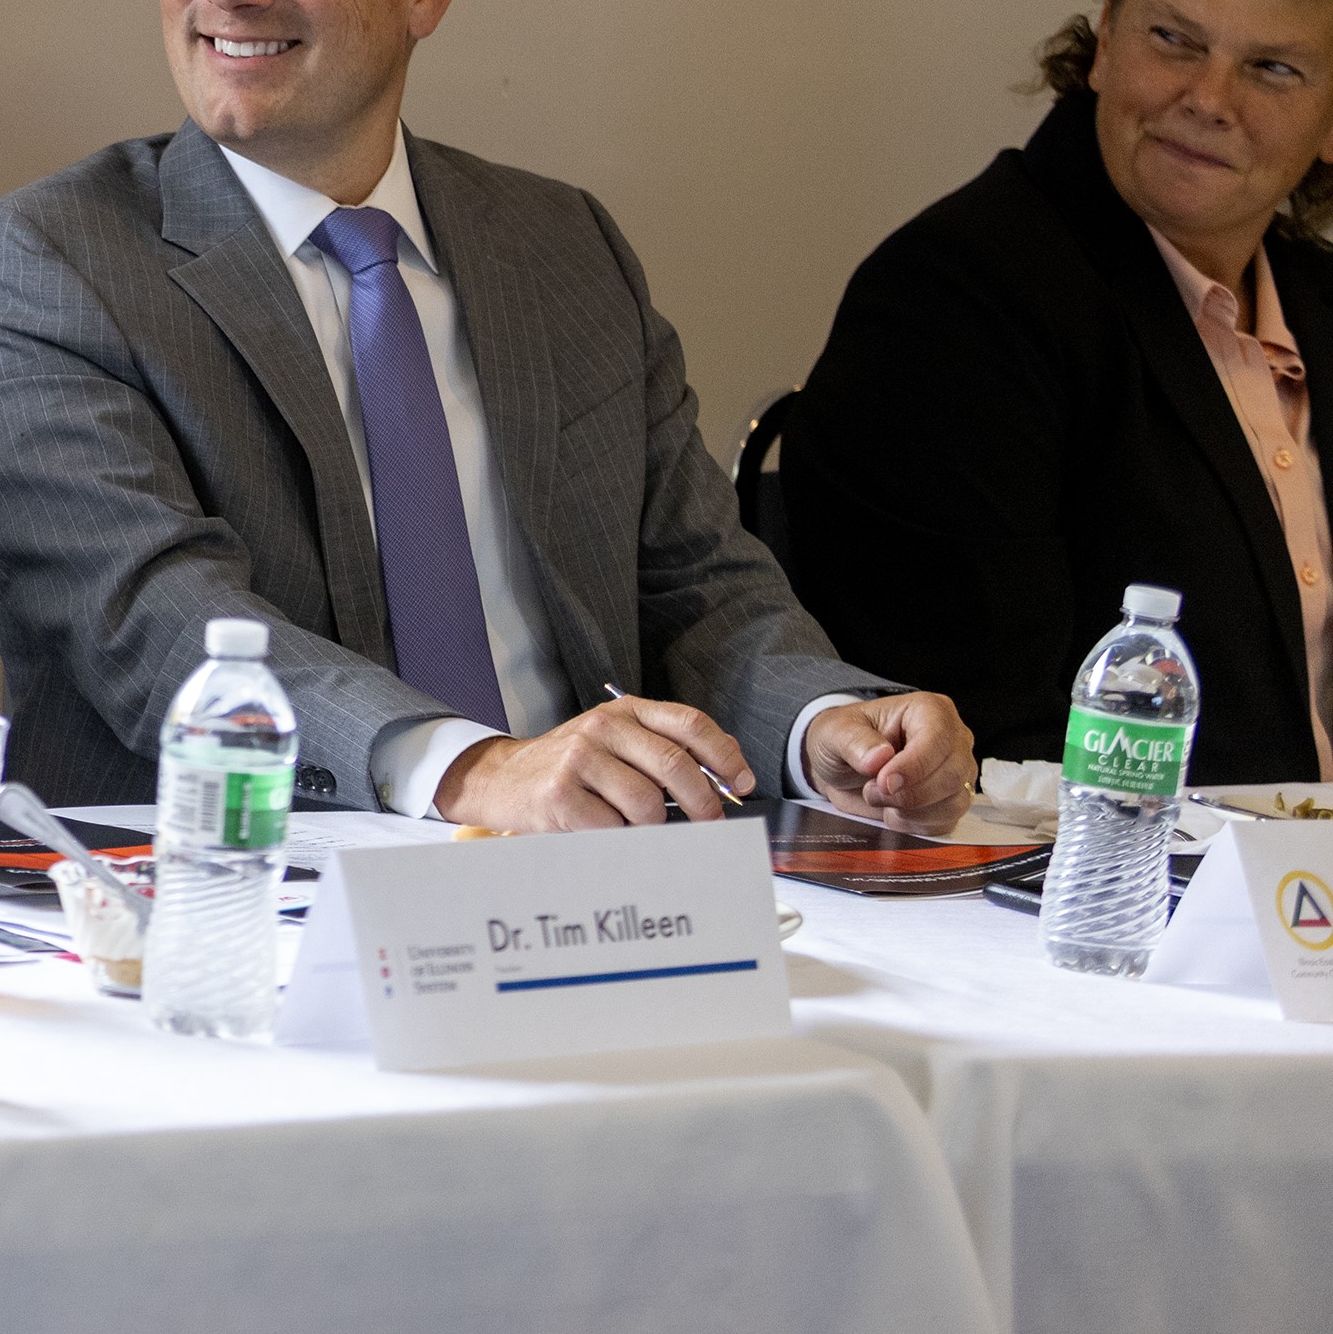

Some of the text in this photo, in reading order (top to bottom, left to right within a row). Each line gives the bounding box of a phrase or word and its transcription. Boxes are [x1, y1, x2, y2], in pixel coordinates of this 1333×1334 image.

[1083, 726, 1175, 762] GLACIER
[1087, 763, 1119, 776] NATURAL
[1119, 769, 1144, 779] SPRING
[1098, 754, 1160, 773] CLEAR
[487, 905, 693, 953] Dr. Tim Killeen
